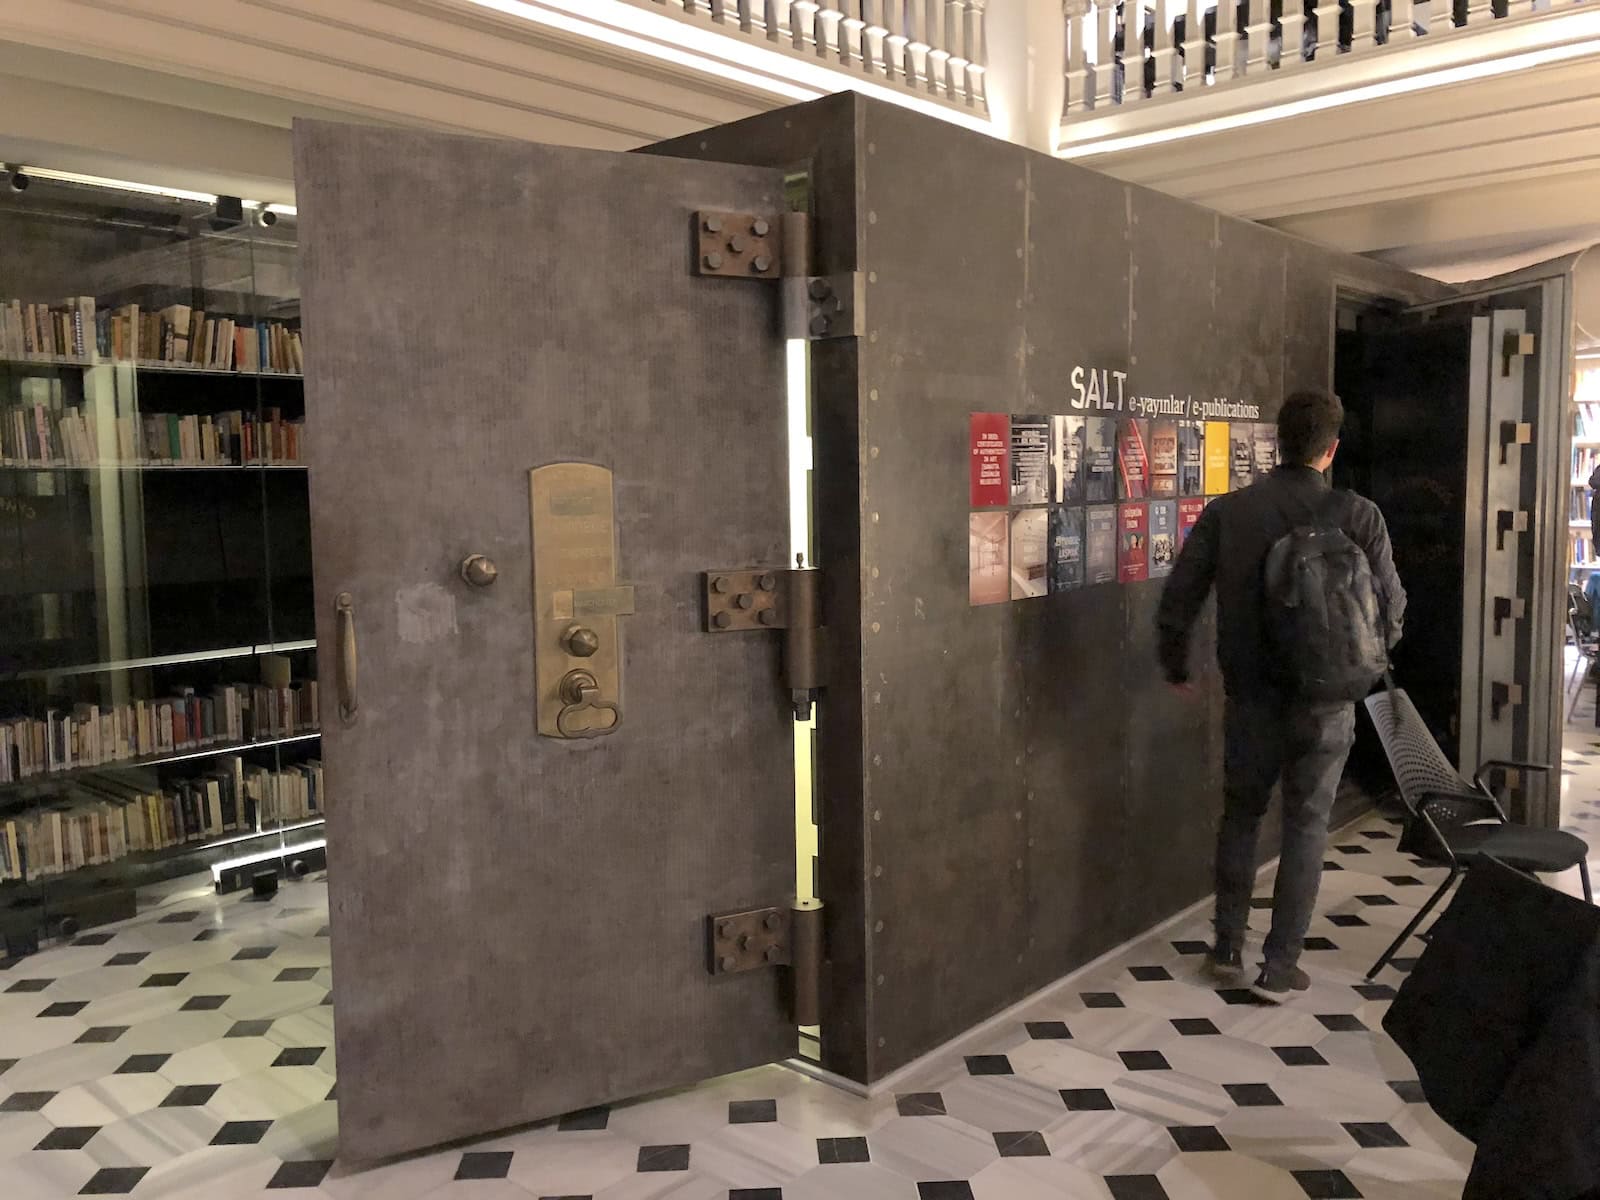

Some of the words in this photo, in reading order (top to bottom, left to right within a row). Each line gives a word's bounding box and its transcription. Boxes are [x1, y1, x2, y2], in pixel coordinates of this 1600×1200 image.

[1071, 366, 1127, 411] SALT
[1129, 394, 1185, 418] e-yayınlar
[1192, 398, 1260, 419] e-publications
